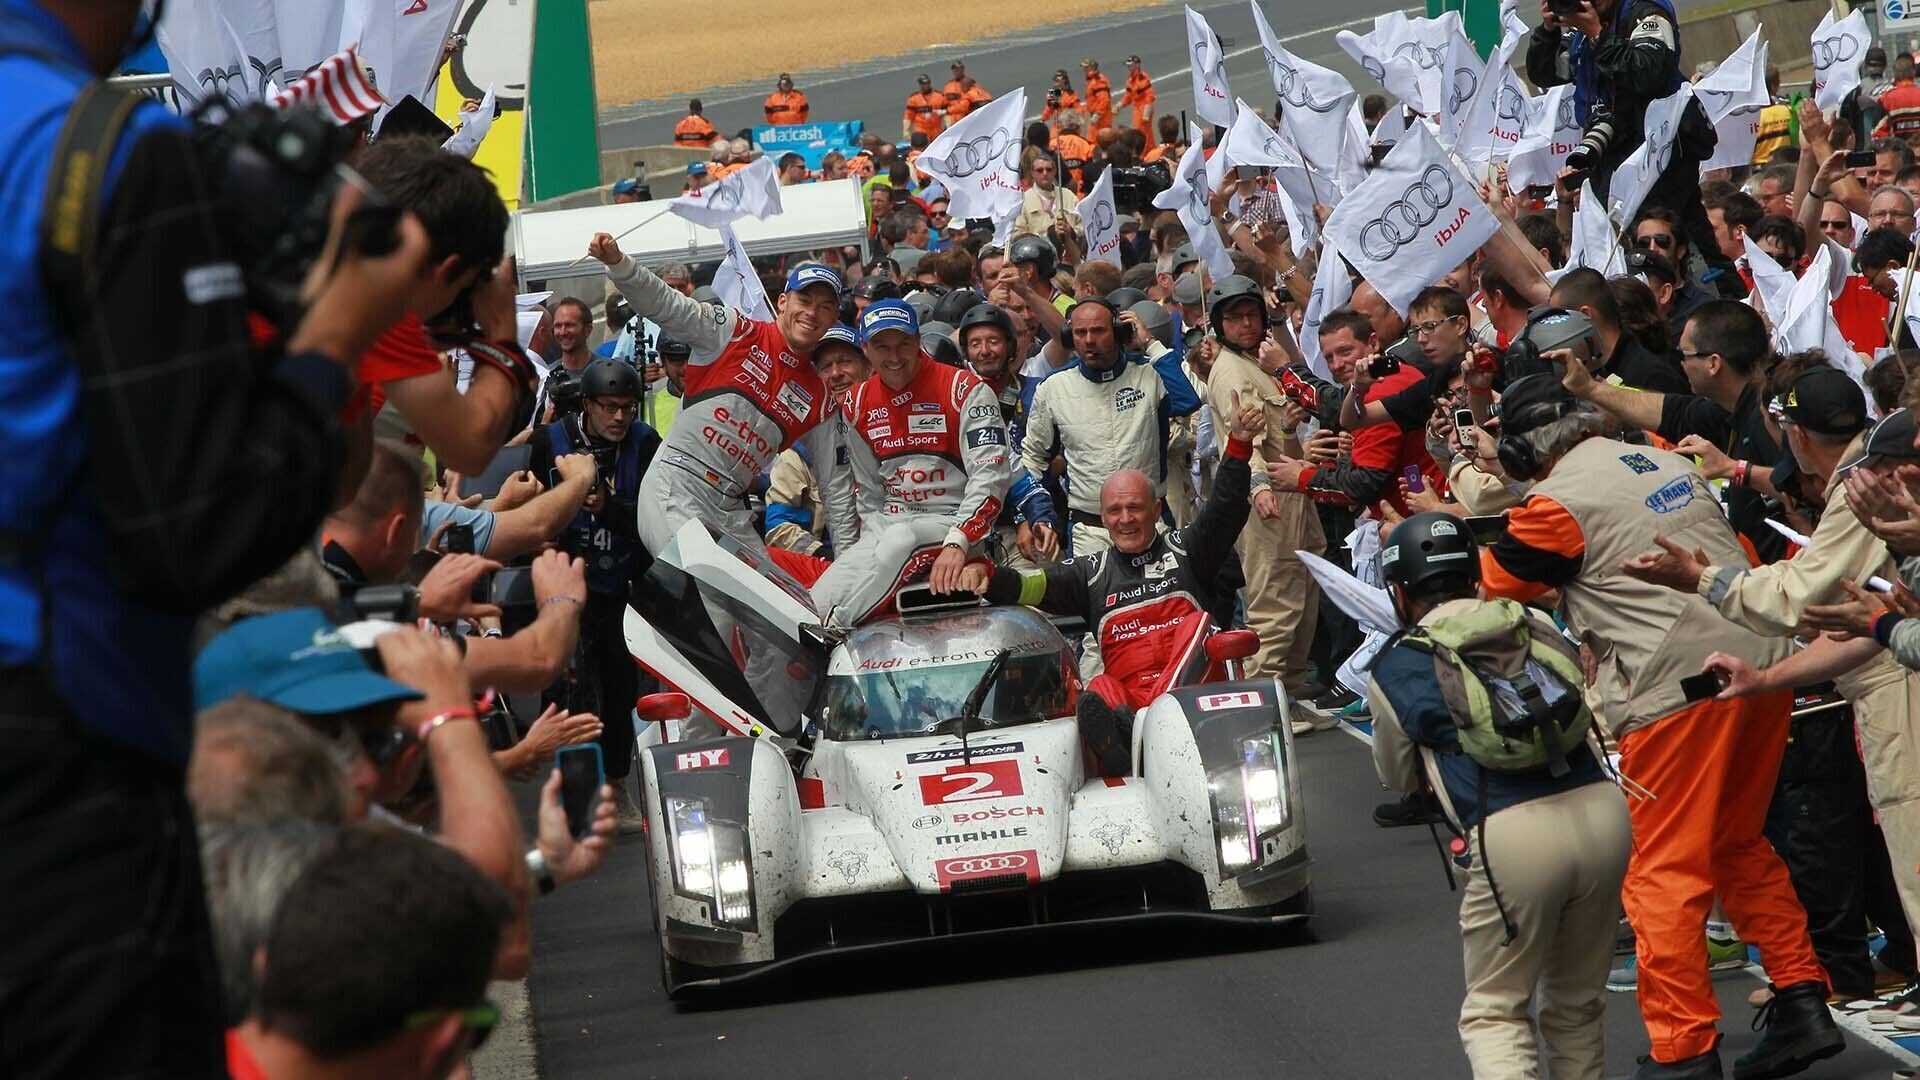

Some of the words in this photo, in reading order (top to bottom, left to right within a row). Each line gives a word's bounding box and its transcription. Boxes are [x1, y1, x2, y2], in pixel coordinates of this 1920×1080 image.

[777, 126, 823, 142] adcash
[749, 381, 770, 402] Audi
[882, 438, 905, 449] Audi
[907, 436, 938, 446] Sport
[978, 428, 998, 441] 24h
[1649, 494, 1664, 508] LE
[1662, 481, 1692, 503] MANS
[1119, 584, 1146, 601] Audi
[1149, 576, 1178, 594] Sport
[1111, 618, 1141, 635] Audi
[857, 658, 903, 671] Audi
[908, 651, 978, 666] e-tron
[1209, 694, 1251, 708] P1
[677, 748, 728, 770] HY
[941, 771, 1003, 802] 2
[952, 806, 1045, 823] BOSCH
[935, 827, 1028, 845] MAHLE
